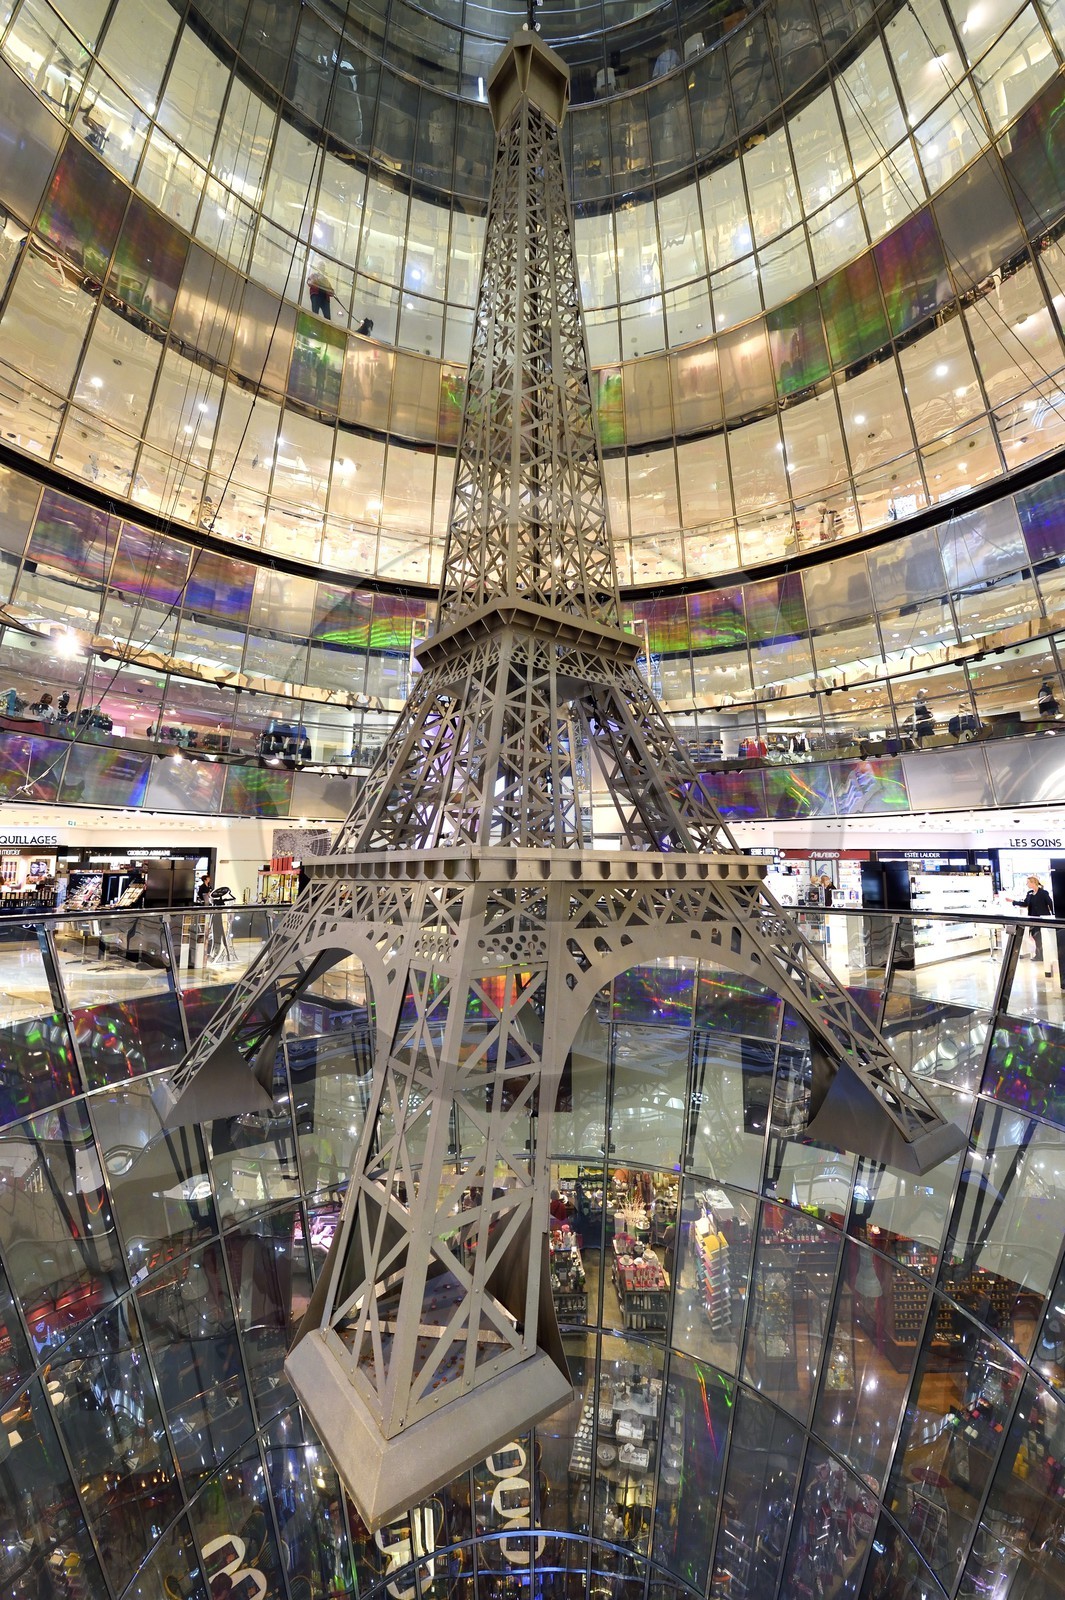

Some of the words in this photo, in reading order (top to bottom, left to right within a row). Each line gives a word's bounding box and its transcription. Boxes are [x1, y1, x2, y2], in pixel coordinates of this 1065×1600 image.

[1009, 838, 1028, 848] LES
[1030, 838, 1062, 848] SOINS
[808, 851, 840, 859] SHISEIDO
